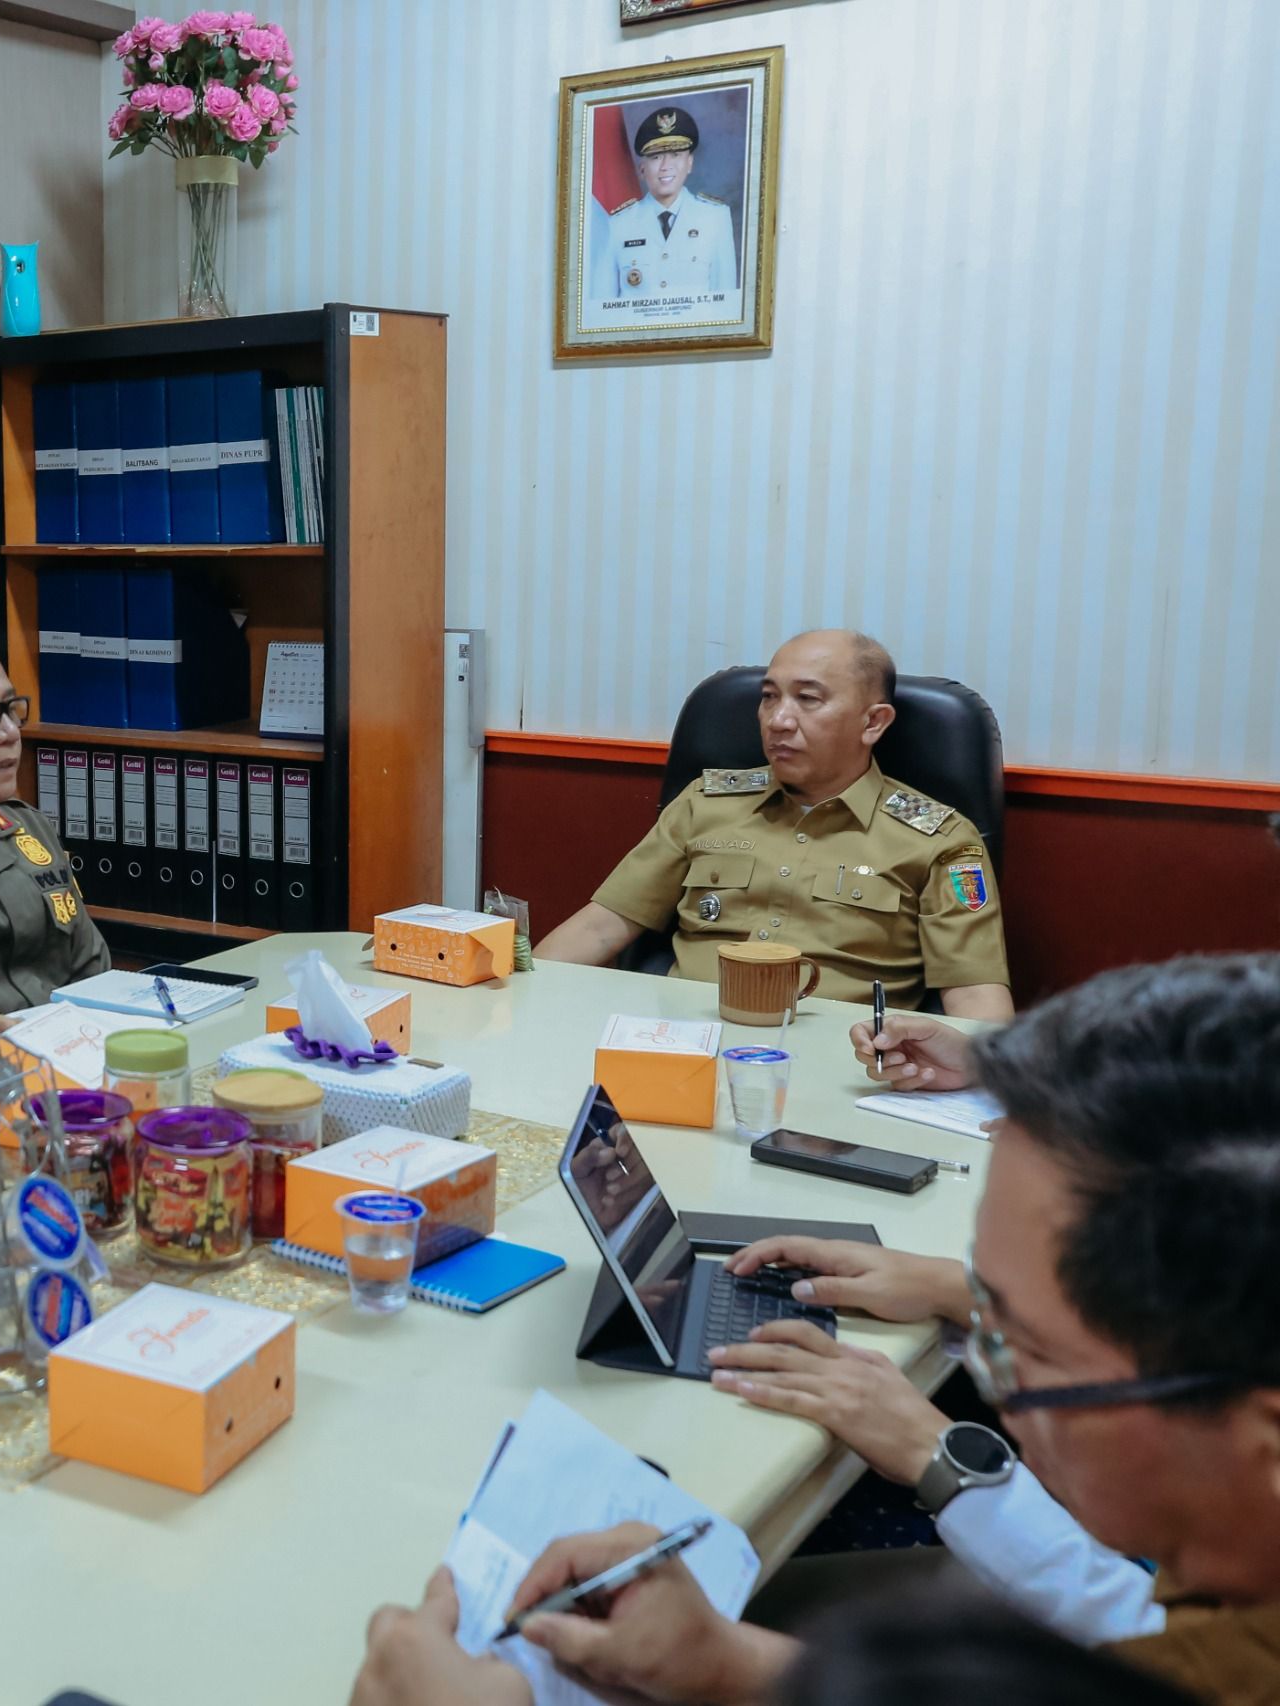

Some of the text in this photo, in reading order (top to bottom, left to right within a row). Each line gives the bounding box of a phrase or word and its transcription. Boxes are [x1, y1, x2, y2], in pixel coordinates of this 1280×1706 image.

[602, 300, 630, 310] RAHMAT
[631, 299, 661, 308] MIRZANI
[662, 296, 695, 306] DJAUSAL,
[713, 294, 725, 302] MM
[221, 449, 263, 460] DINAS PUPR
[126, 459, 159, 468] BALITBANG
